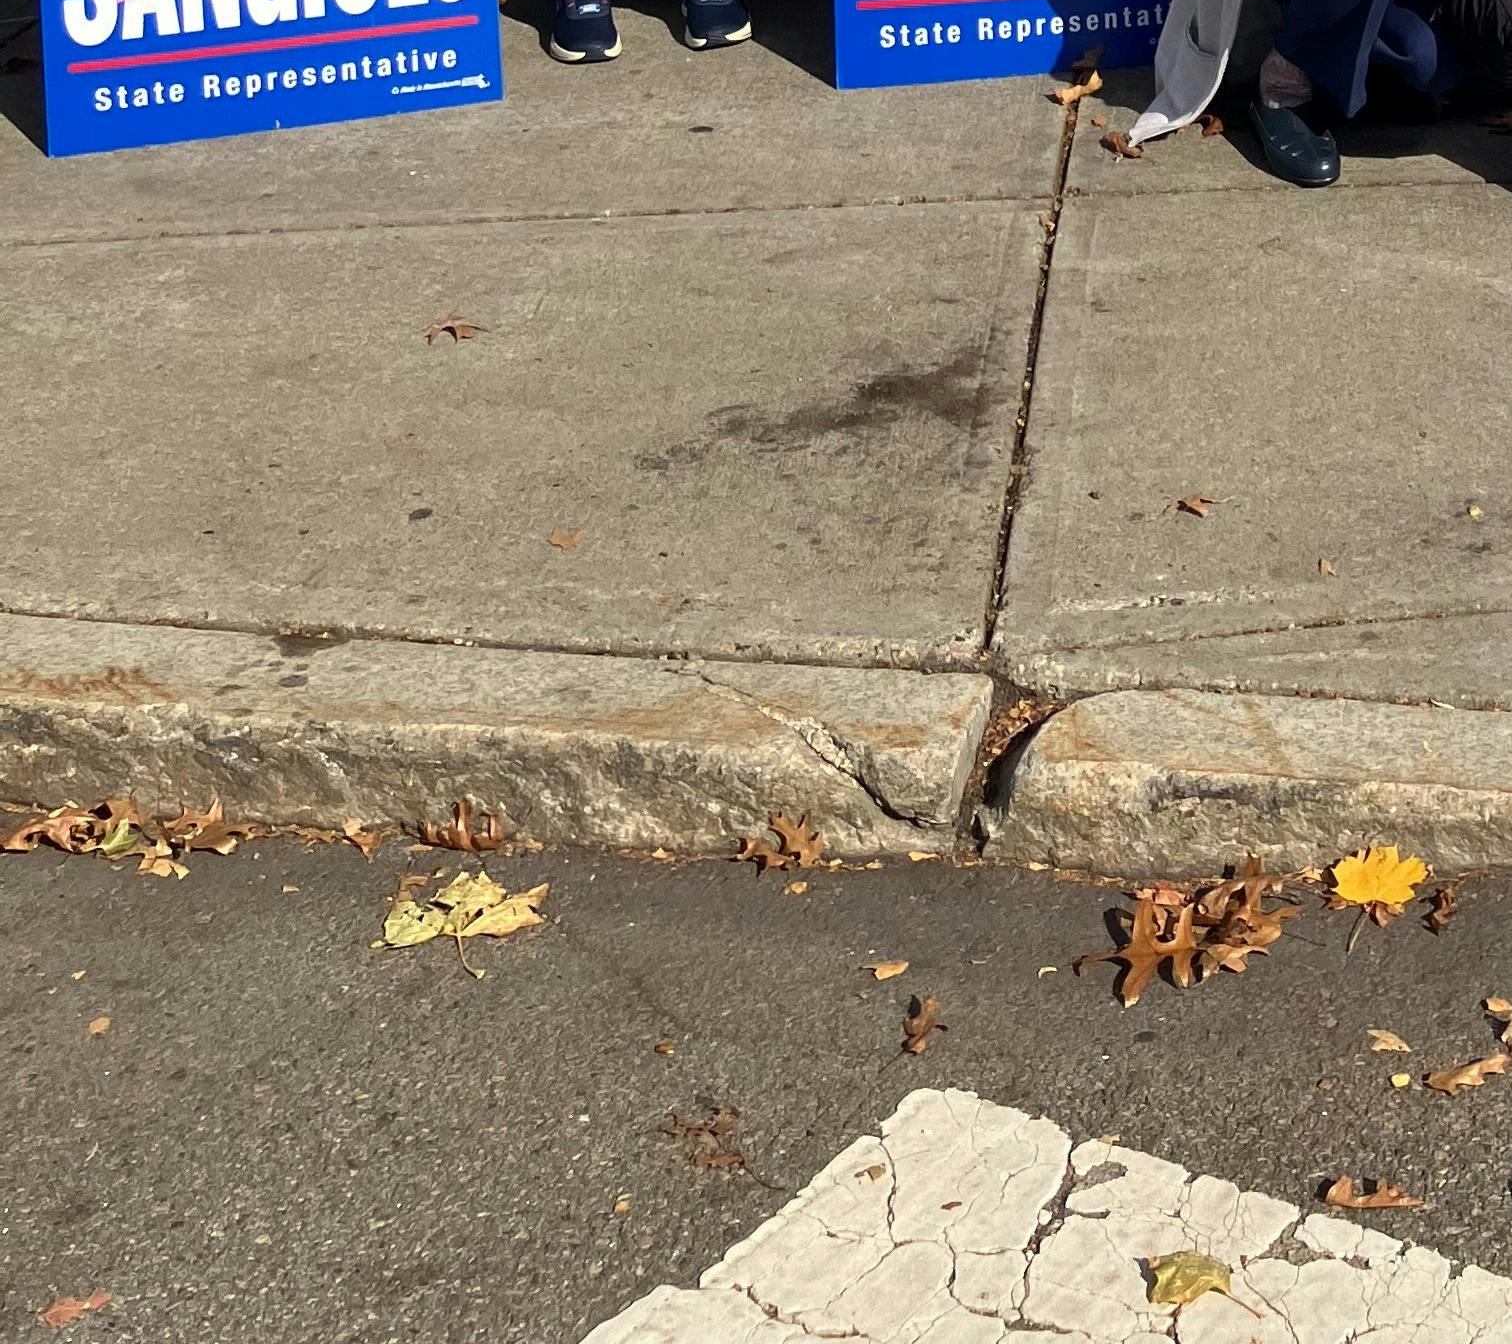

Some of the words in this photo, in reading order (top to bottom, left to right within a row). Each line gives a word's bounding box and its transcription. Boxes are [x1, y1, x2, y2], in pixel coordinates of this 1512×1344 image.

[879, 20, 962, 50] State
[978, 3, 1165, 43] Representat
[93, 82, 185, 112] State
[203, 46, 459, 99] Representative
